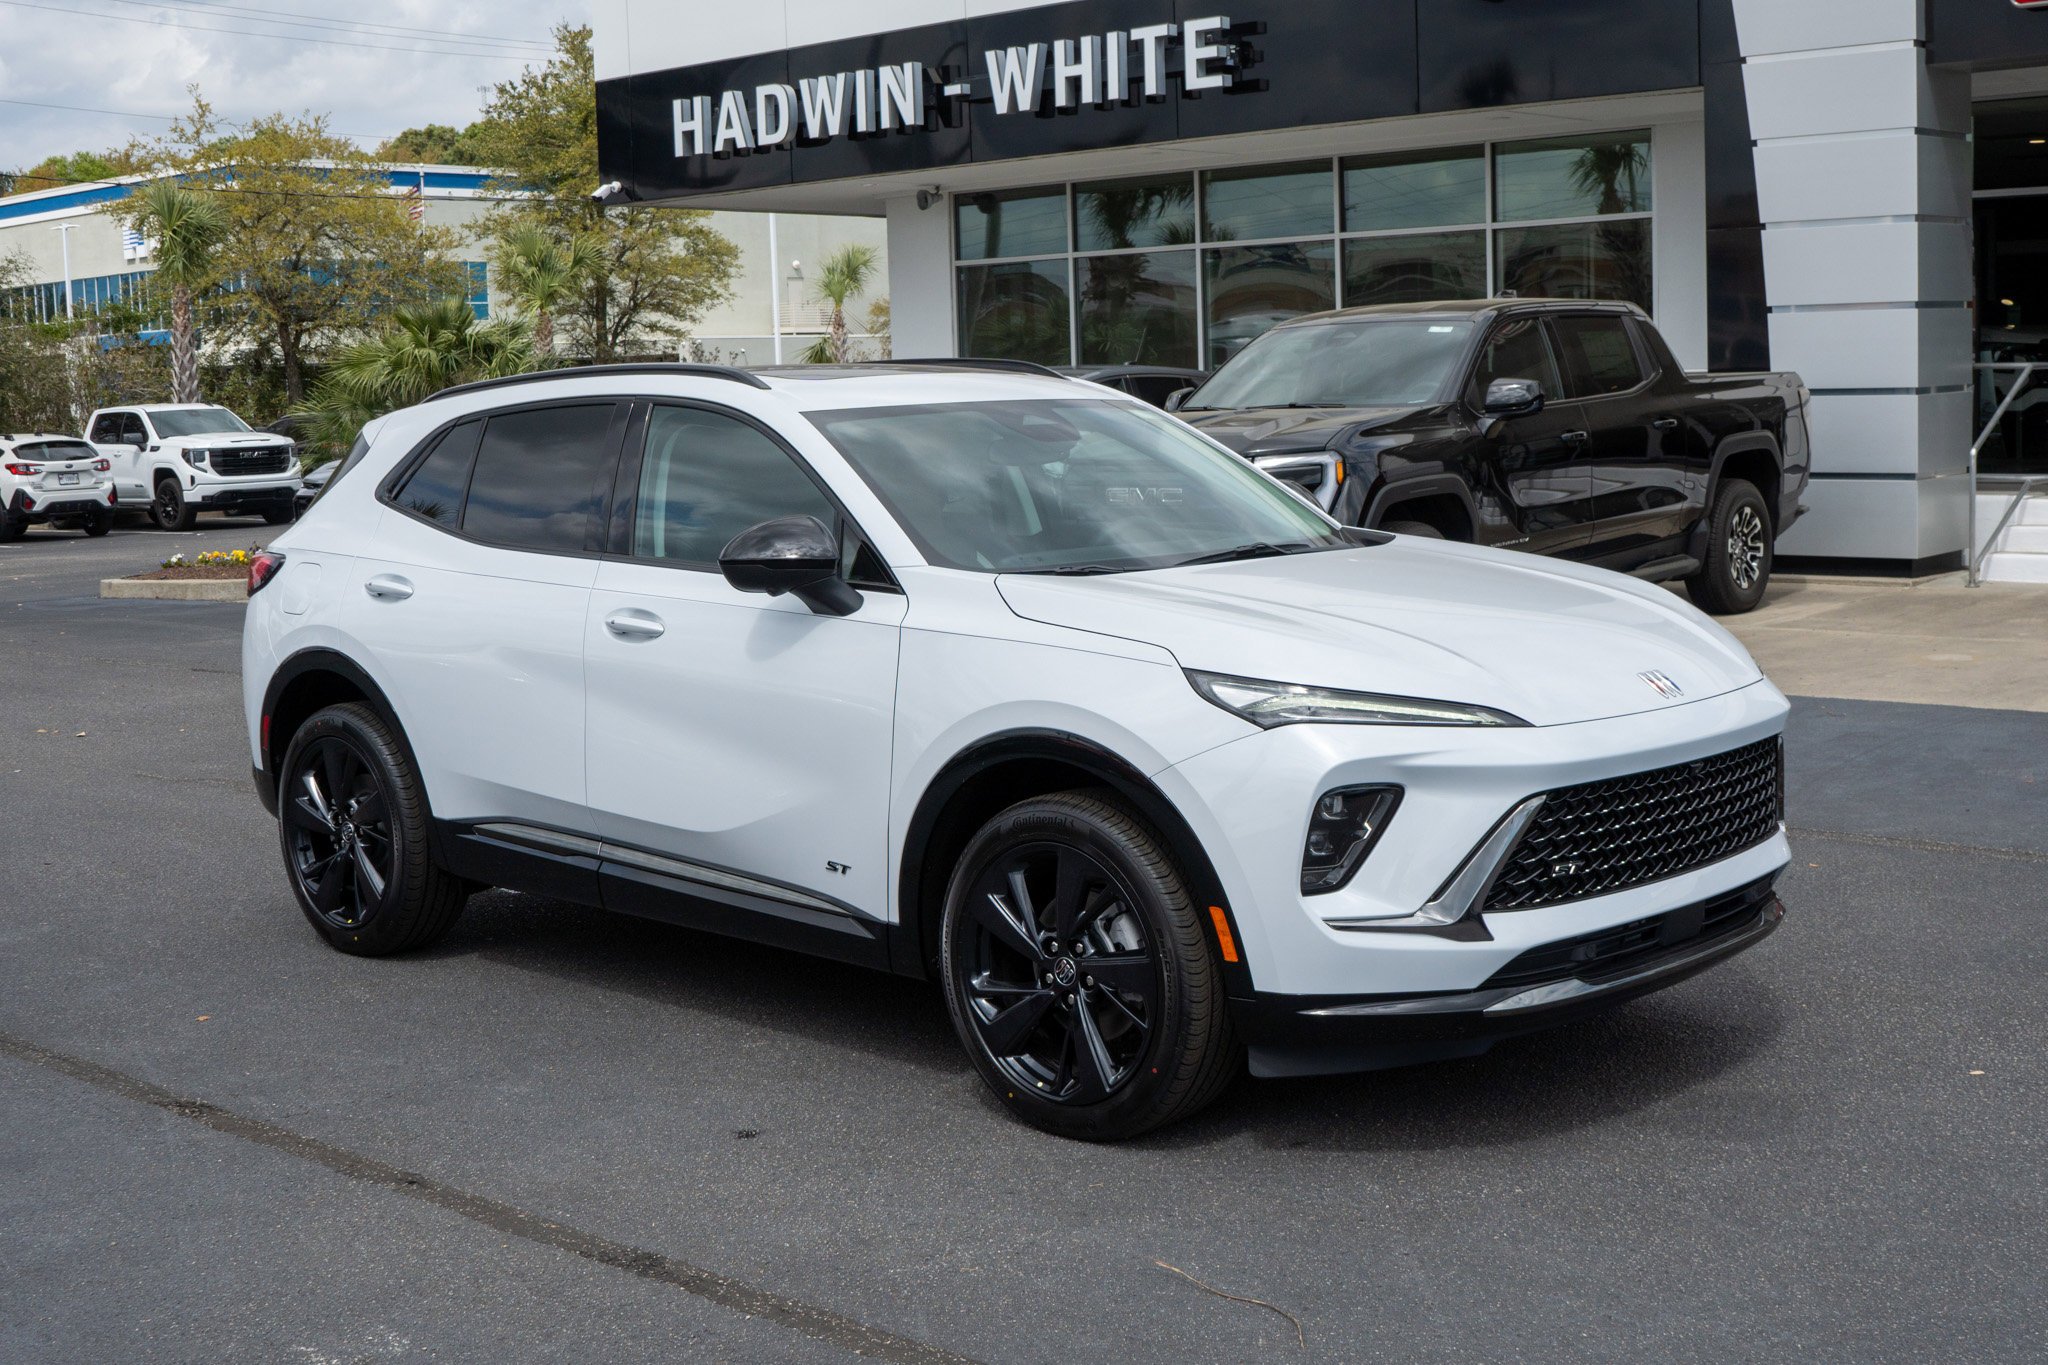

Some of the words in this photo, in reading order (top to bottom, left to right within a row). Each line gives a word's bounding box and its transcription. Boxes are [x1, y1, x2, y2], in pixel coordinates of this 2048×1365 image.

[673, 61, 925, 158] HADWIN
[985, 15, 1231, 115] WHITE
[1105, 487, 1183, 503] GMC
[825, 860, 852, 876] ST
[1551, 861, 1582, 877] ST
